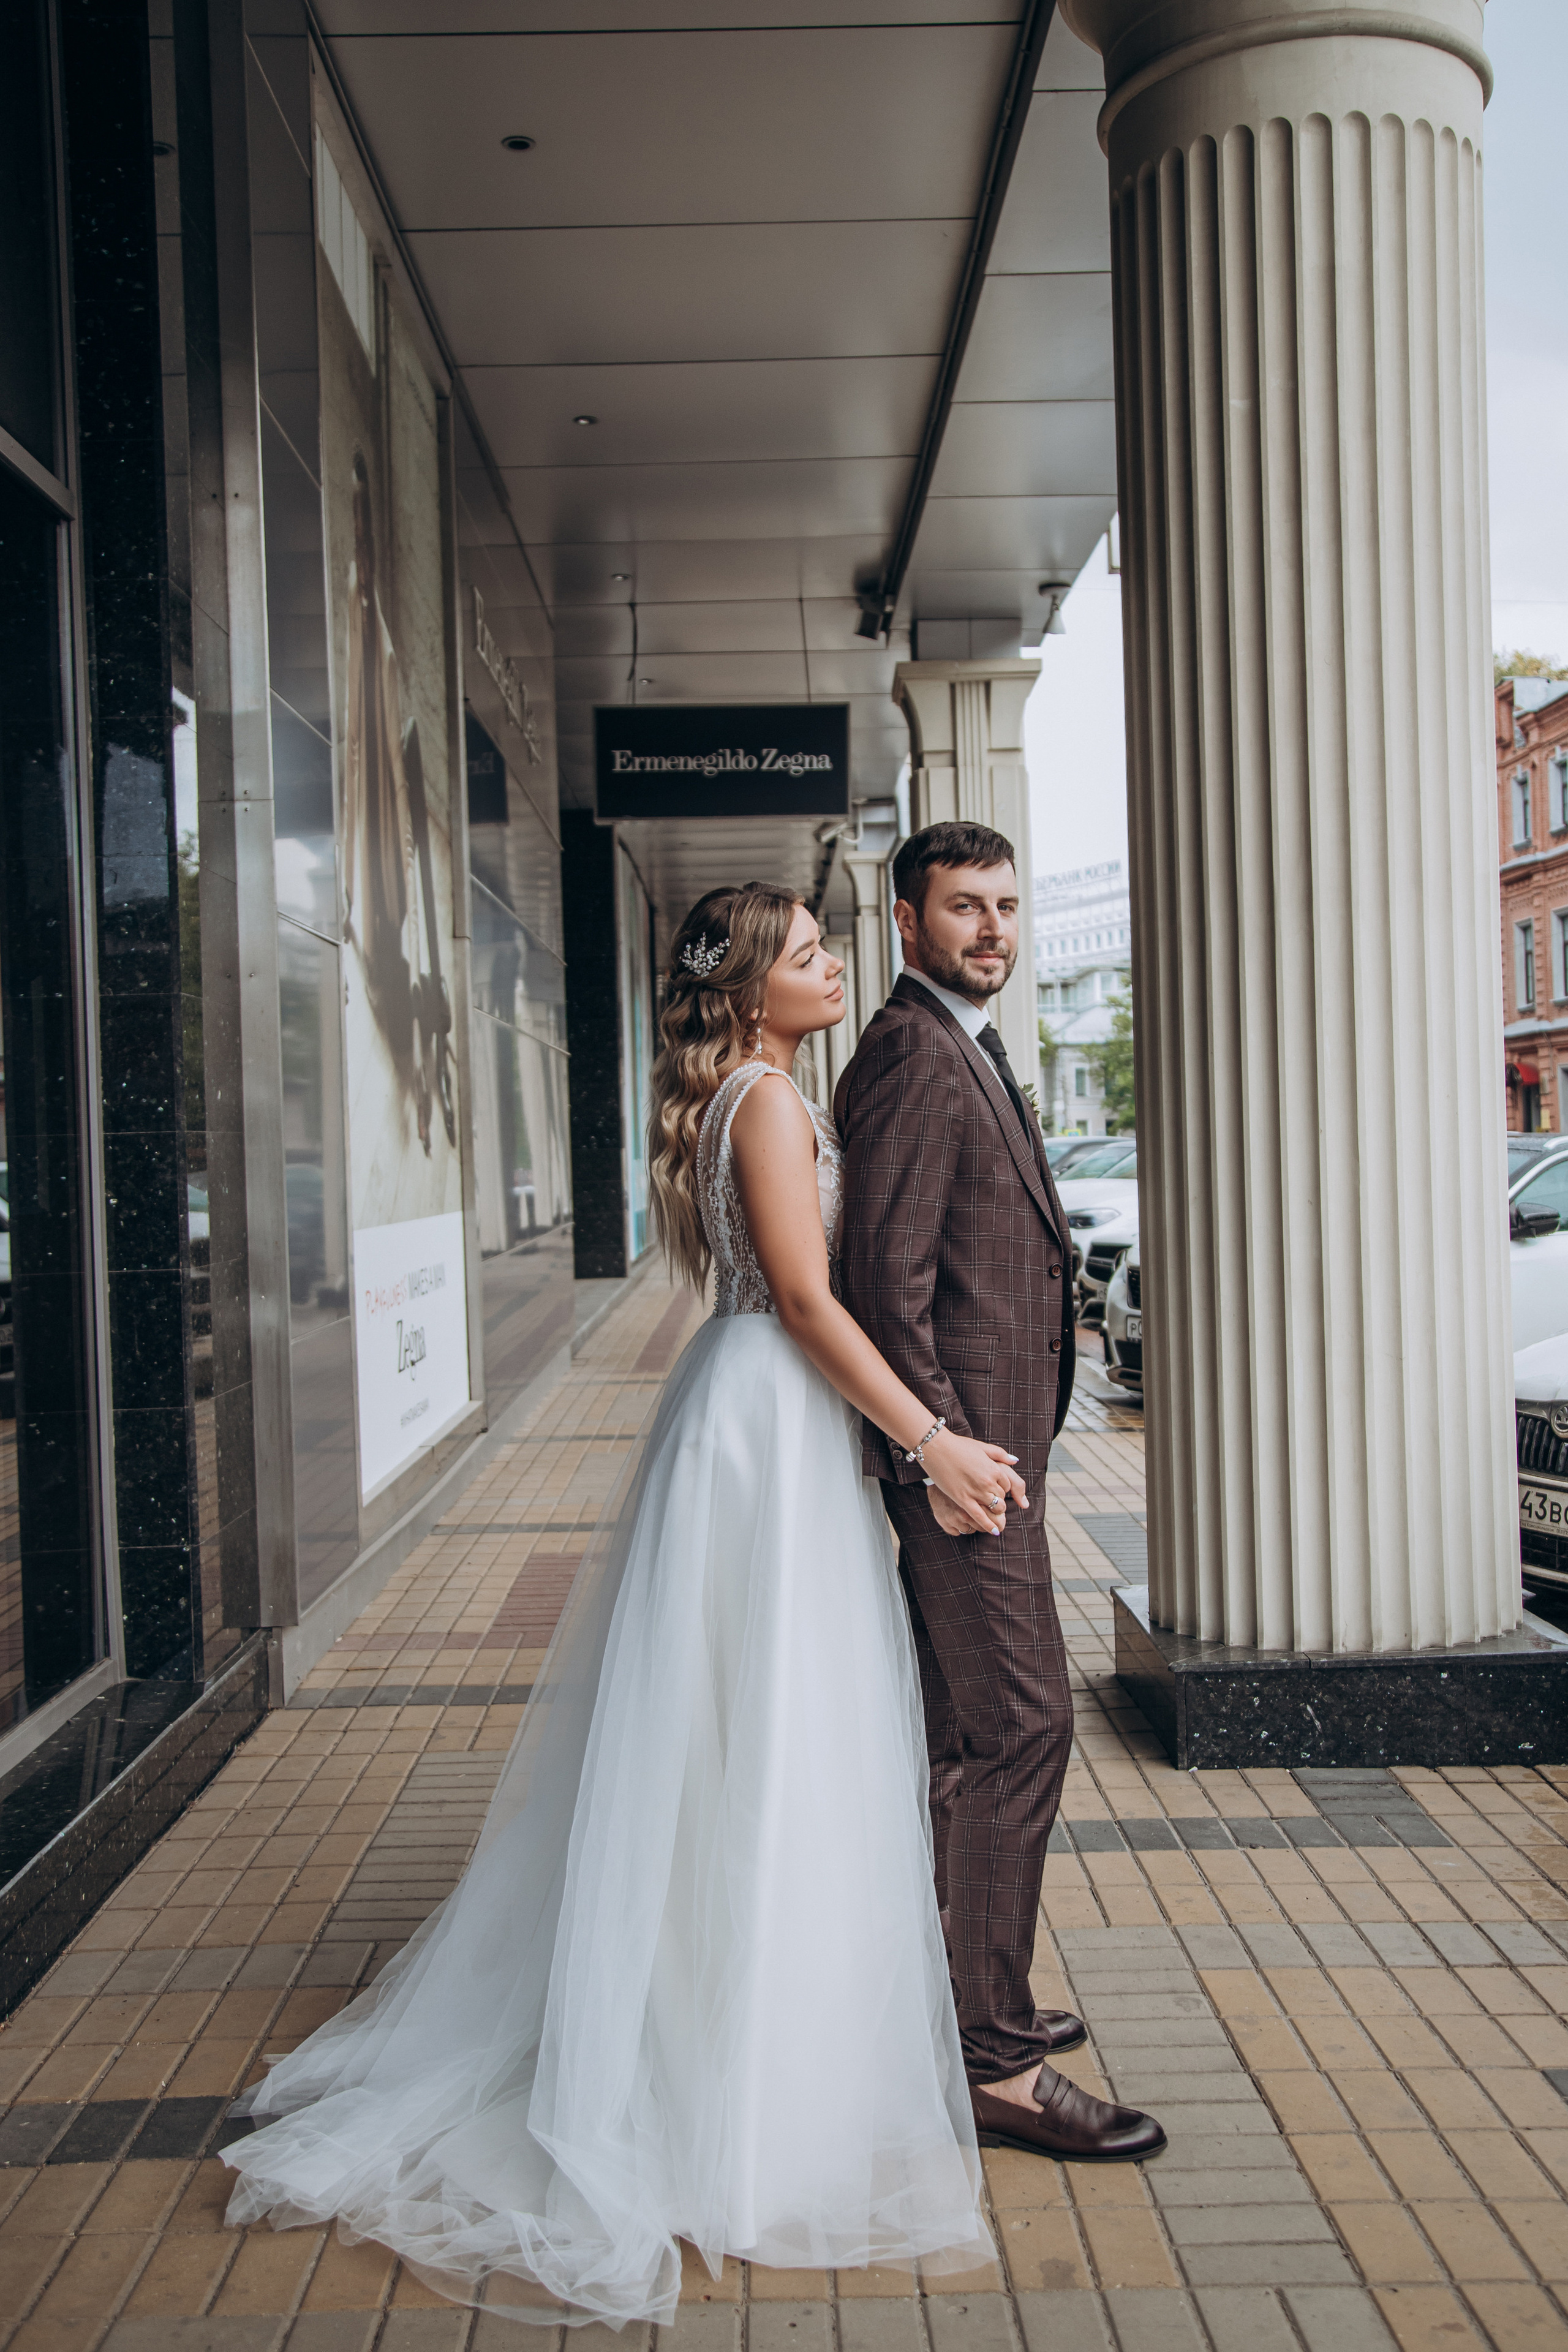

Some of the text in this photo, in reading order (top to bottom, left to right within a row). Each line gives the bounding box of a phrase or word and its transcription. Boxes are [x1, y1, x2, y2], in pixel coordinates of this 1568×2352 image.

[611, 748, 832, 777] Ermenegildo Zegna
[1084, 859, 1121, 879] РОССИИ
[396, 1319, 426, 1381] Zegna
